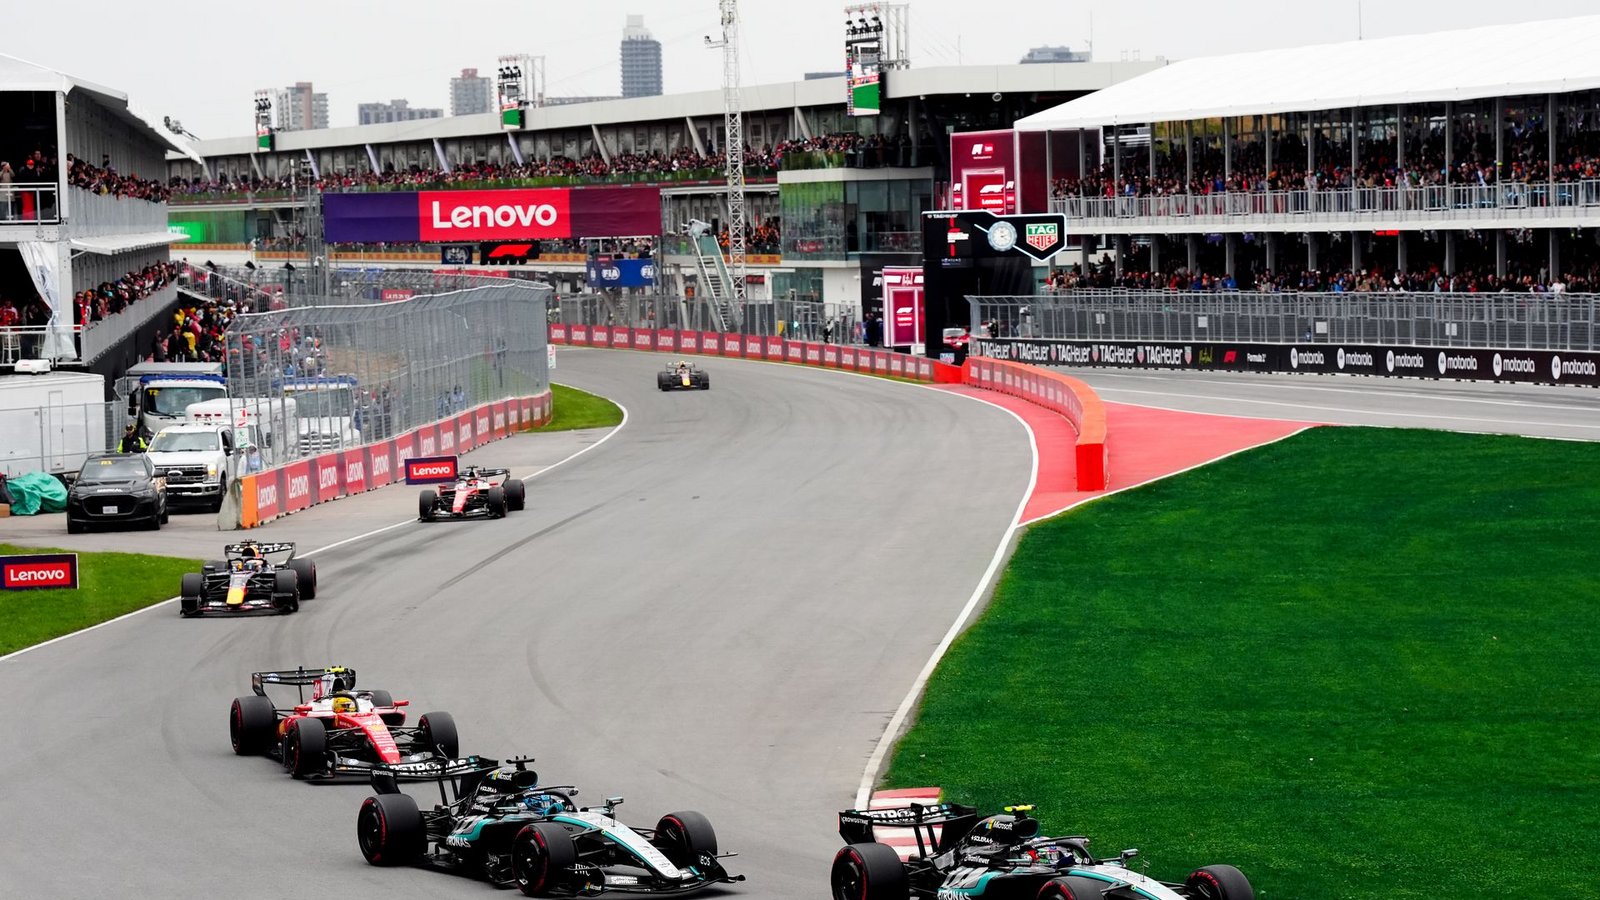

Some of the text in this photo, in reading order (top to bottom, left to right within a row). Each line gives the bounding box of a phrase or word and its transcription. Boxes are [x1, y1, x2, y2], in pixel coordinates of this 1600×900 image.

[432, 200, 557, 229] Lenovo
[1030, 225, 1055, 234] TAG
[1028, 234, 1057, 248] HEUER
[602, 268, 619, 278] FIA
[1299, 350, 1324, 364] motorola
[1346, 352, 1373, 366] motorola
[1395, 353, 1424, 368] motorola
[1447, 355, 1477, 370] motorola
[1503, 356, 1535, 373] motorola
[1562, 359, 1596, 376] motorola
[346, 459, 364, 482] Lenovo
[372, 453, 389, 476] Lenovo
[413, 465, 450, 476] Lenovo
[319, 464, 337, 490] Lenovo
[288, 474, 309, 499] Lenovo
[257, 483, 277, 509] Lenovo
[10, 569, 65, 581] Lenovo
[992, 820, 1013, 831] Microsoft
